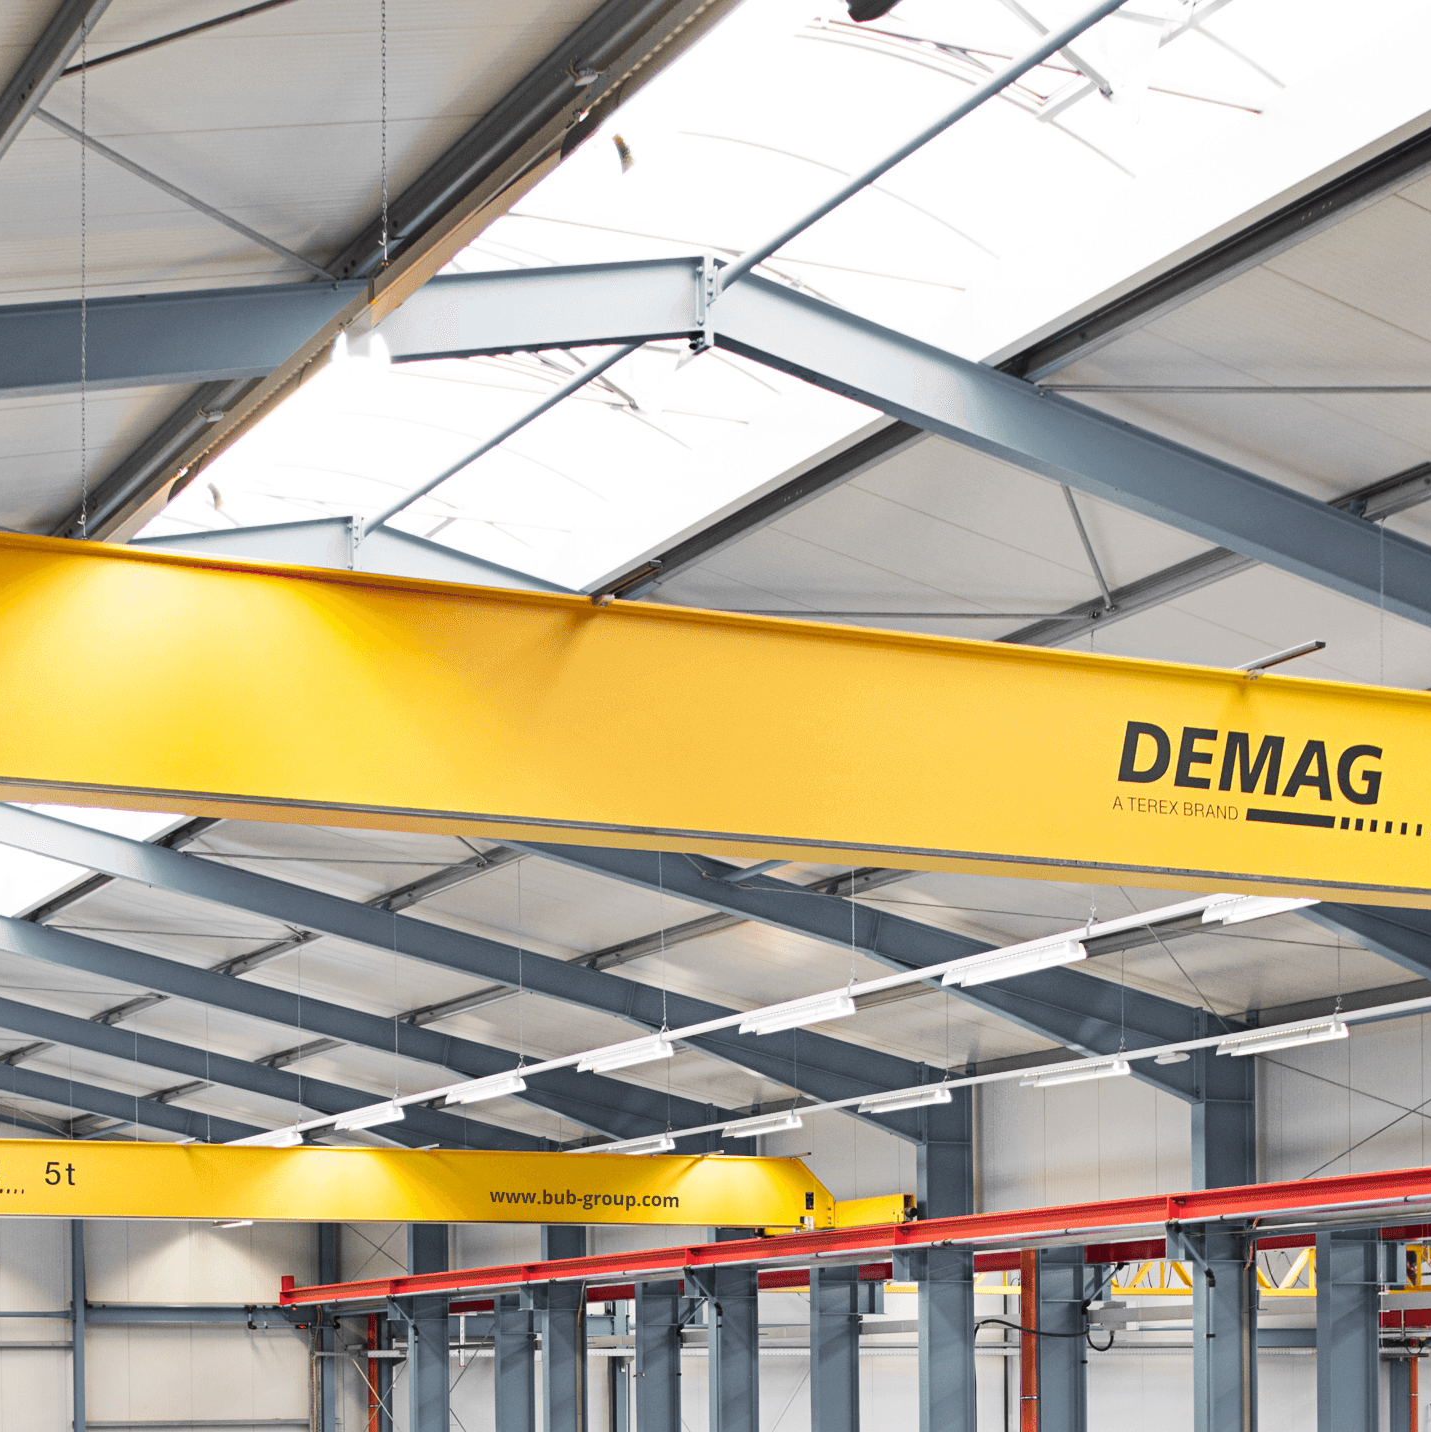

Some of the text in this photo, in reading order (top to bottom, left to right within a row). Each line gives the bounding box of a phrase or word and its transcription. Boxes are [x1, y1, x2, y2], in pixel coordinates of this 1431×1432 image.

[1117, 720, 1383, 806] DEMAG
[1112, 796, 1239, 821] A TEREX BRAND
[489, 1188, 680, 1211] www.bub-group.com
